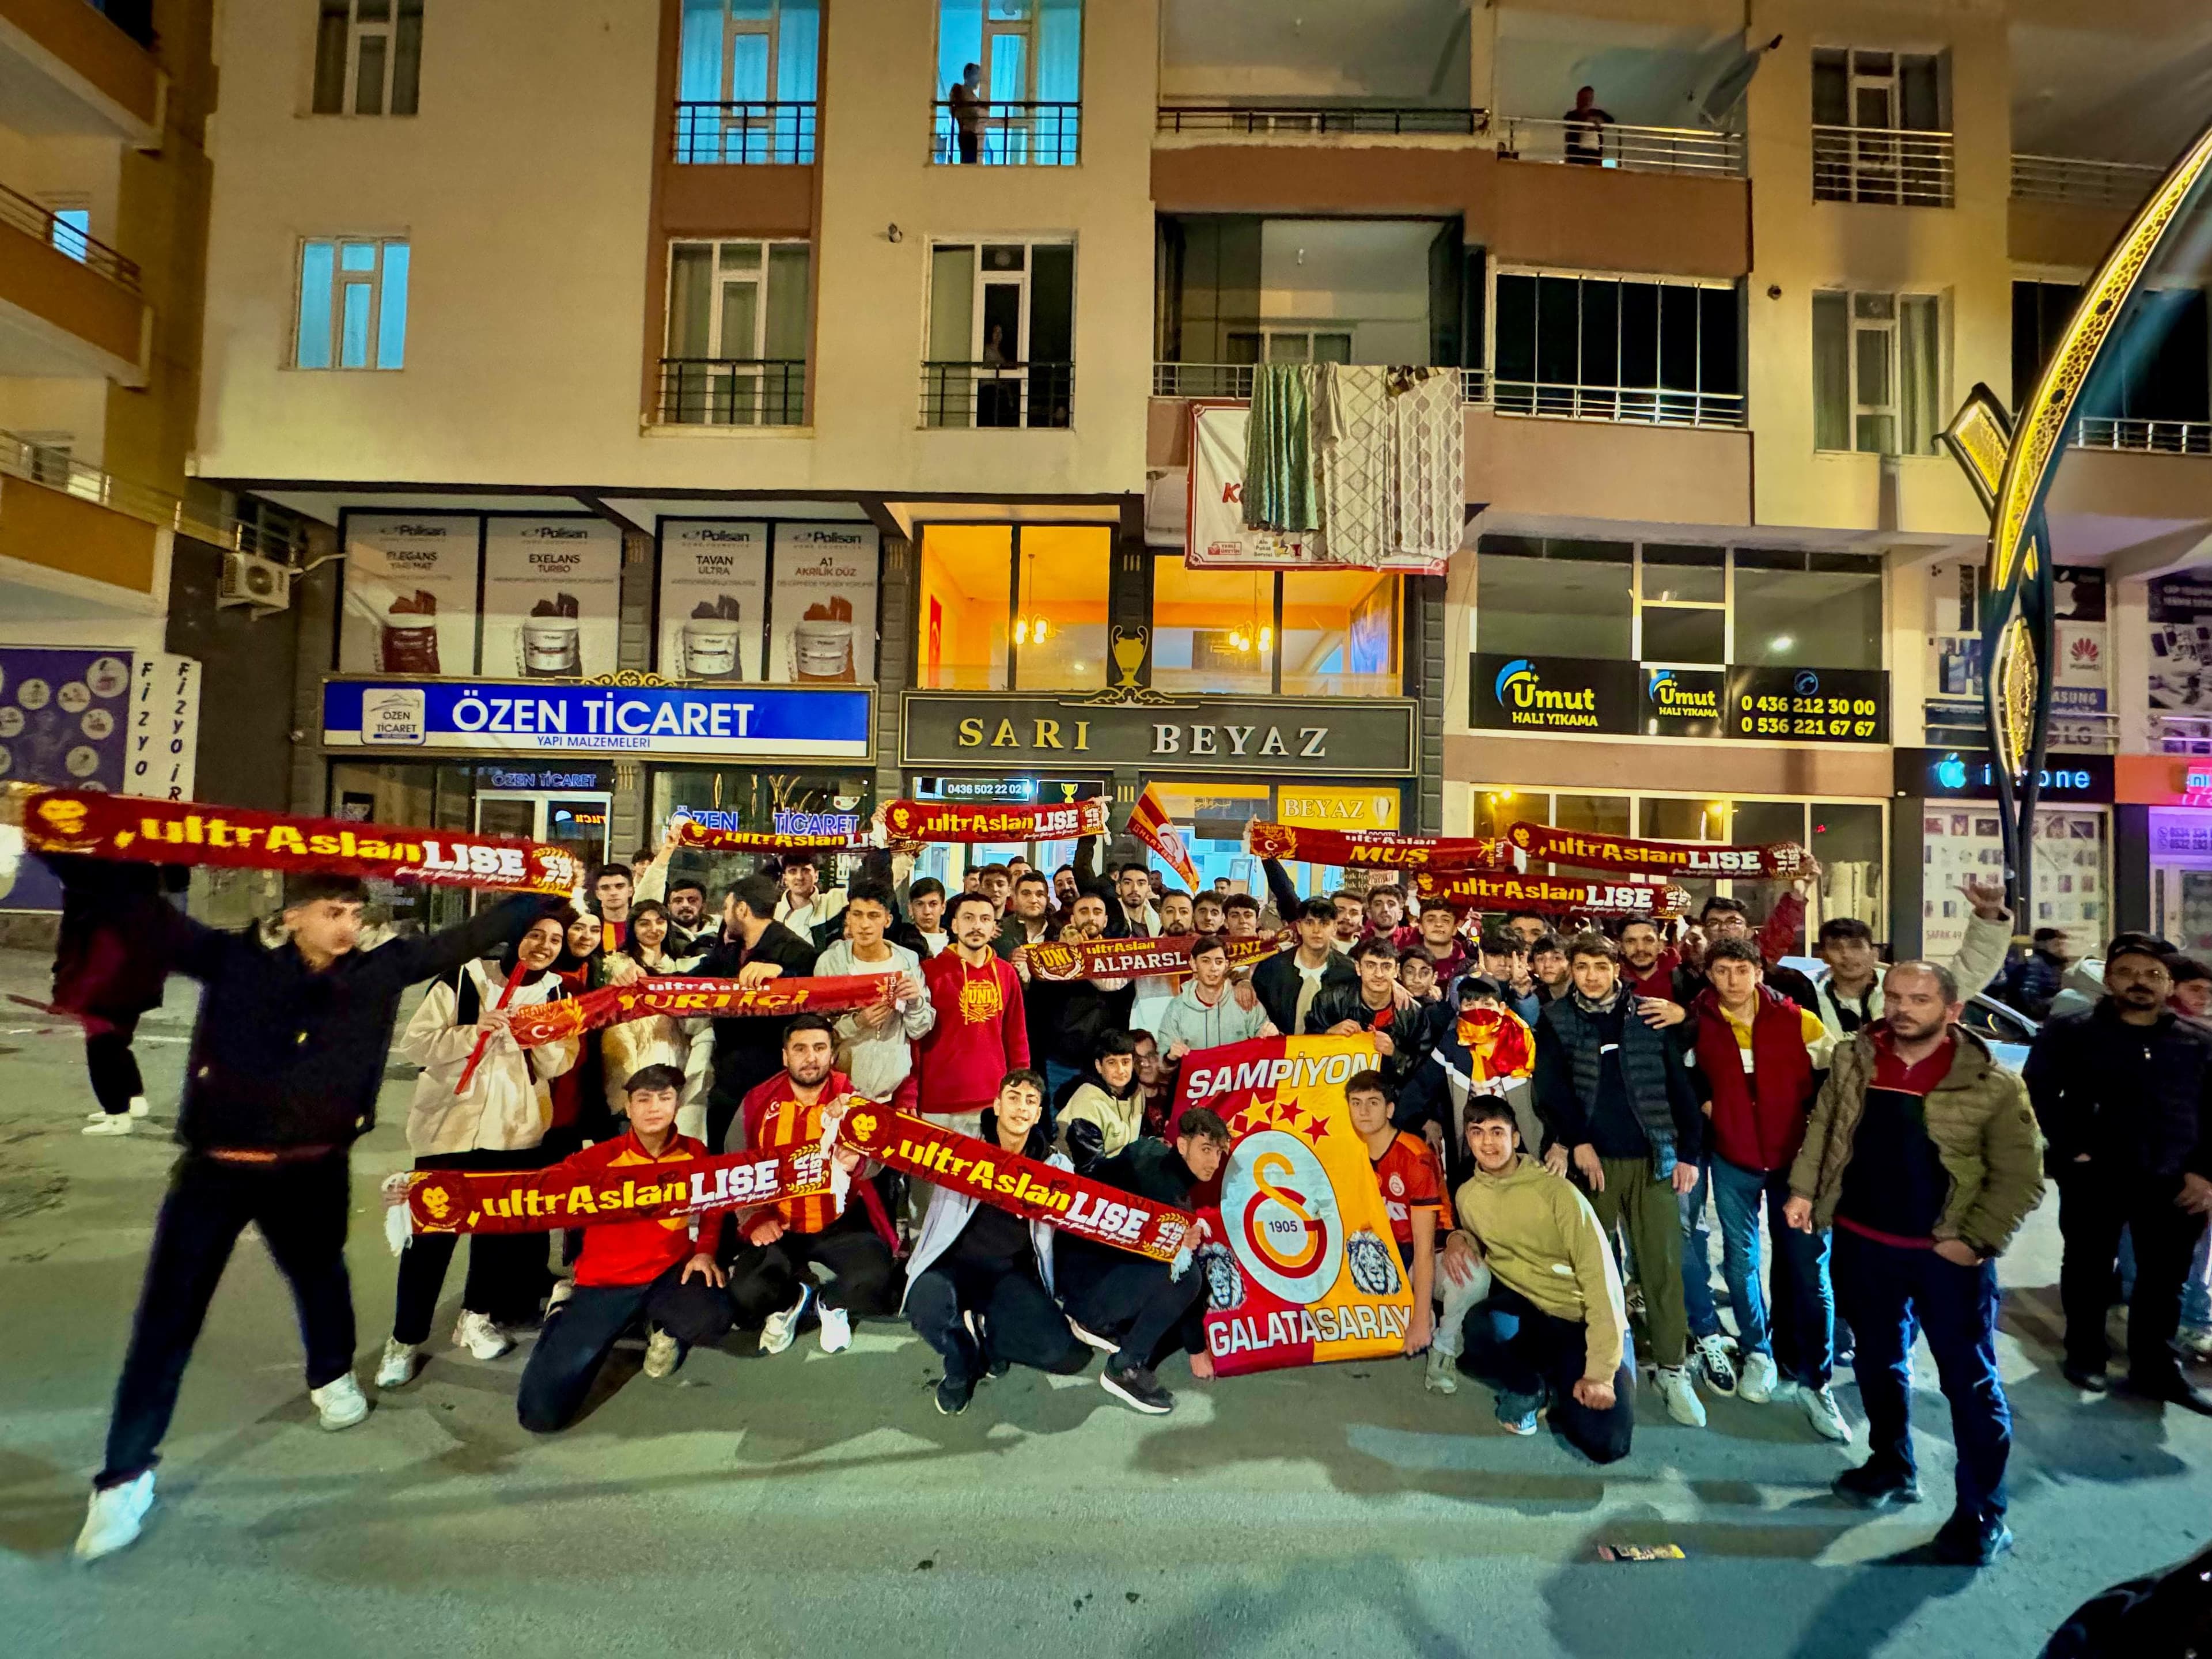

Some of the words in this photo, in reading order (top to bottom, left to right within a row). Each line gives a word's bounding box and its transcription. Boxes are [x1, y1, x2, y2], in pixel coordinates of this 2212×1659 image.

[540, 527, 588, 539] Polisan
[702, 529, 749, 541] Polisan
[813, 531, 861, 544] Polisan
[528, 554, 581, 564] EXELANS
[538, 565, 571, 573] TURBO
[696, 555, 733, 565] TAVAN
[819, 557, 833, 567] A1
[698, 566, 730, 575] ULTRA
[1513, 683, 1596, 710] Umut
[1660, 686, 1715, 706] Umut
[1741, 695, 1752, 712] 0
[1756, 696, 1788, 713] 436
[1792, 697, 1824, 714] 212
[1828, 698, 1850, 715] 30
[1853, 699, 1876, 716] 00
[452, 690, 567, 733] ÖZEN
[582, 692, 754, 737] TİCARET
[1512, 711, 1546, 725] HALI
[1547, 713, 1599, 728] YIKAMA
[1659, 706, 1681, 717] HALI
[1681, 707, 1718, 718] YIKAMA
[959, 718, 1090, 751] SARI
[1152, 724, 1330, 757] BEYAZ
[1741, 717, 1752, 733] 0
[1757, 717, 1789, 734] 536
[1793, 718, 1825, 735] 221
[1829, 720, 1850, 737] 67
[1854, 721, 1876, 738] 67
[2063, 725, 2092, 745] LG
[537, 736, 563, 747] YAPI
[568, 735, 651, 749] MALZEMELERİ
[947, 783, 974, 795] 0436
[974, 783, 994, 795] 502
[994, 784, 1007, 795] 22
[1009, 784, 1022, 796] 02
[1282, 798, 1365, 819] BEYAZ
[774, 806, 860, 835] TİCARET
[927, 811, 1035, 832] ultrAslan
[1034, 808, 1079, 833] LISE
[141, 815, 421, 863] ultrAslan
[422, 840, 527, 877] LISE
[846, 833, 879, 849] LIS
[1344, 833, 1437, 846] ultrAslan
[1350, 846, 1430, 868] MUŞ
[1549, 838, 1687, 865] ultrAslan
[1688, 850, 1762, 871] LISE
[1453, 878, 1585, 901] ultrAslan
[1586, 885, 1654, 908] LISE
[1039, 947, 1073, 967] UNI
[1086, 941, 1156, 955] ultrAslan
[1093, 951, 1188, 974] ALPARSL
[968, 988, 992, 1005] UNI
[1186, 1051, 1381, 1106] ŞAMPİYON
[483, 1180, 687, 1218] ultrAslan
[690, 1158, 779, 1205] LISE
[899, 1138, 1071, 1211] ultrAslan
[1065, 1191, 1150, 1239] LISE
[1268, 1220, 1298, 1233] 1905
[1209, 1304, 1412, 1357] GALATASARAY
